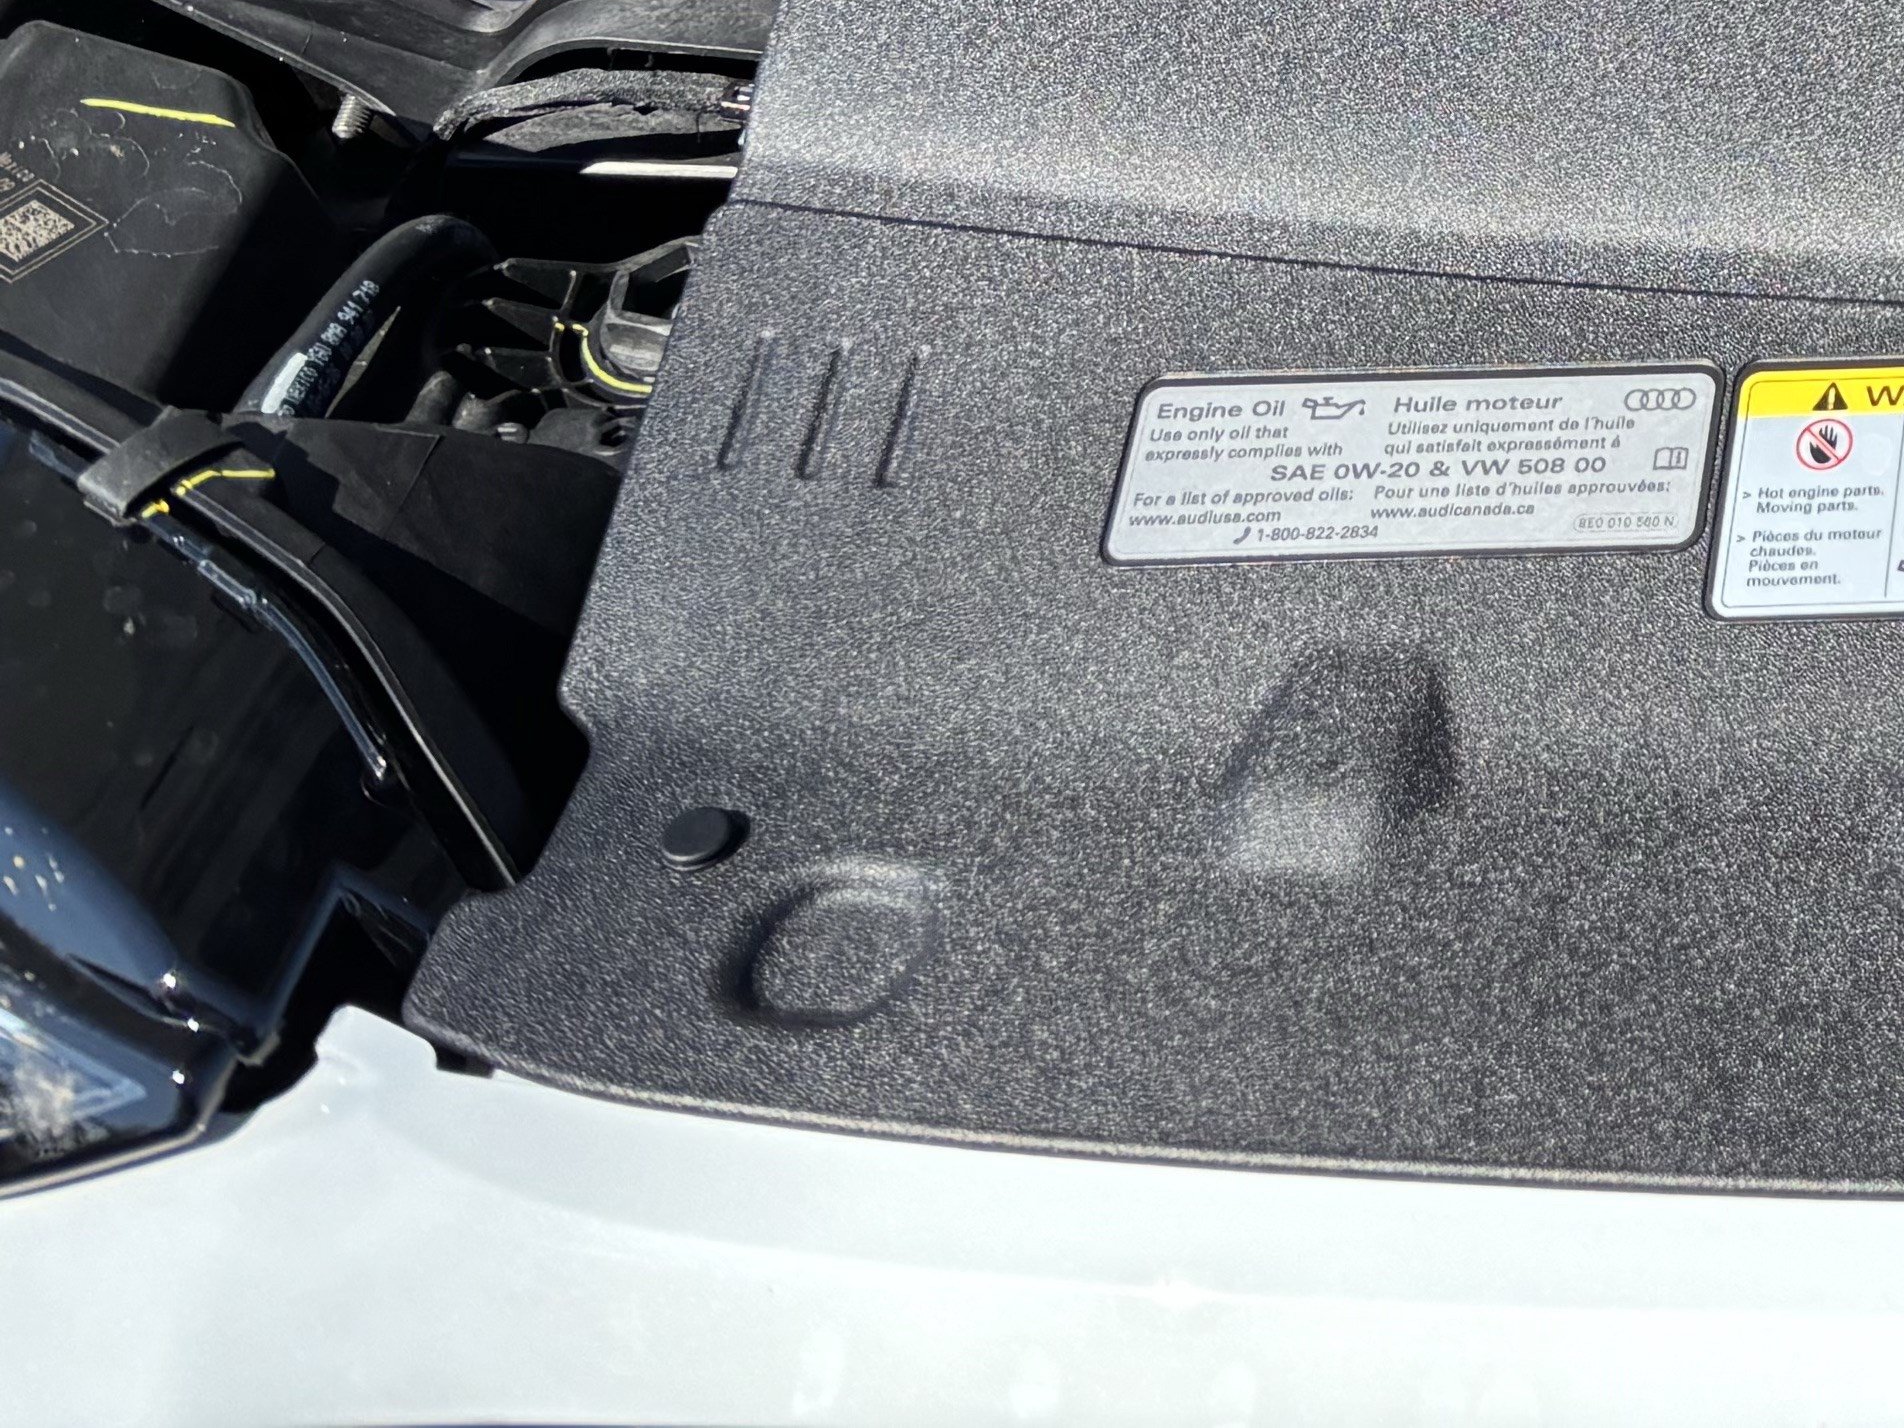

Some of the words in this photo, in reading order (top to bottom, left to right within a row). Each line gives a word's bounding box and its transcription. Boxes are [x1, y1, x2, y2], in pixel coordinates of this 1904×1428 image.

[1157, 403, 1242, 422] Engine
[1252, 400, 1285, 417] Oil
[1393, 396, 1457, 413] Huile
[1466, 396, 1563, 411] moteur
[1150, 428, 1182, 442] Use
[1188, 427, 1224, 443] only
[1230, 426, 1250, 439] oil
[1255, 426, 1288, 439] that
[1388, 419, 1448, 436] Utilisez
[1454, 418, 1554, 436] uniquement
[1559, 417, 1579, 430] de
[1584, 416, 1634, 430] l'huile
[1145, 447, 1224, 462] expressly
[1228, 445, 1301, 461] complies
[1308, 443, 1343, 457] with
[1384, 443, 1410, 457] qui
[1416, 437, 1482, 454] satisfait
[1487, 436, 1606, 454] expressément
[1271, 464, 1326, 481] SAE
[1334, 461, 1420, 480] 0W-20
[1429, 460, 1451, 476] &
[1461, 458, 1510, 476] VW
[1518, 458, 1565, 474] 508
[1574, 456, 1606, 472] 00
[1133, 494, 1159, 507] For
[1165, 495, 1176, 506] a
[1181, 491, 1206, 506] list
[1211, 490, 1230, 504] of
[1233, 488, 1313, 506] approved
[1319, 488, 1353, 502] oils:
[1374, 485, 1414, 500] Pour
[1419, 486, 1450, 498] une
[1456, 484, 1490, 496] liste
[1496, 482, 1562, 496] d'huiles
[1568, 480, 1671, 495] approuvées:
[1758, 487, 1784, 499] Hot
[1788, 487, 1839, 501] engine
[1844, 485, 1884, 499] parts.
[1370, 503, 1535, 520] www.audicanada.ca
[1756, 501, 1812, 515] Moving
[1816, 500, 1858, 513] parts.
[1129, 511, 1281, 527] www.audiusa.com
[1608, 517, 1631, 528] 010
[1257, 525, 1378, 542] 1-800-822-2834
[1752, 530, 1799, 542] Pièces
[1804, 529, 1823, 541] du
[1828, 529, 1882, 541] moteur
[1749, 545, 1816, 557] chaudes.
[1749, 559, 1795, 571] Pièces
[1800, 561, 1818, 571] en
[1747, 574, 1841, 587] mouvement.
